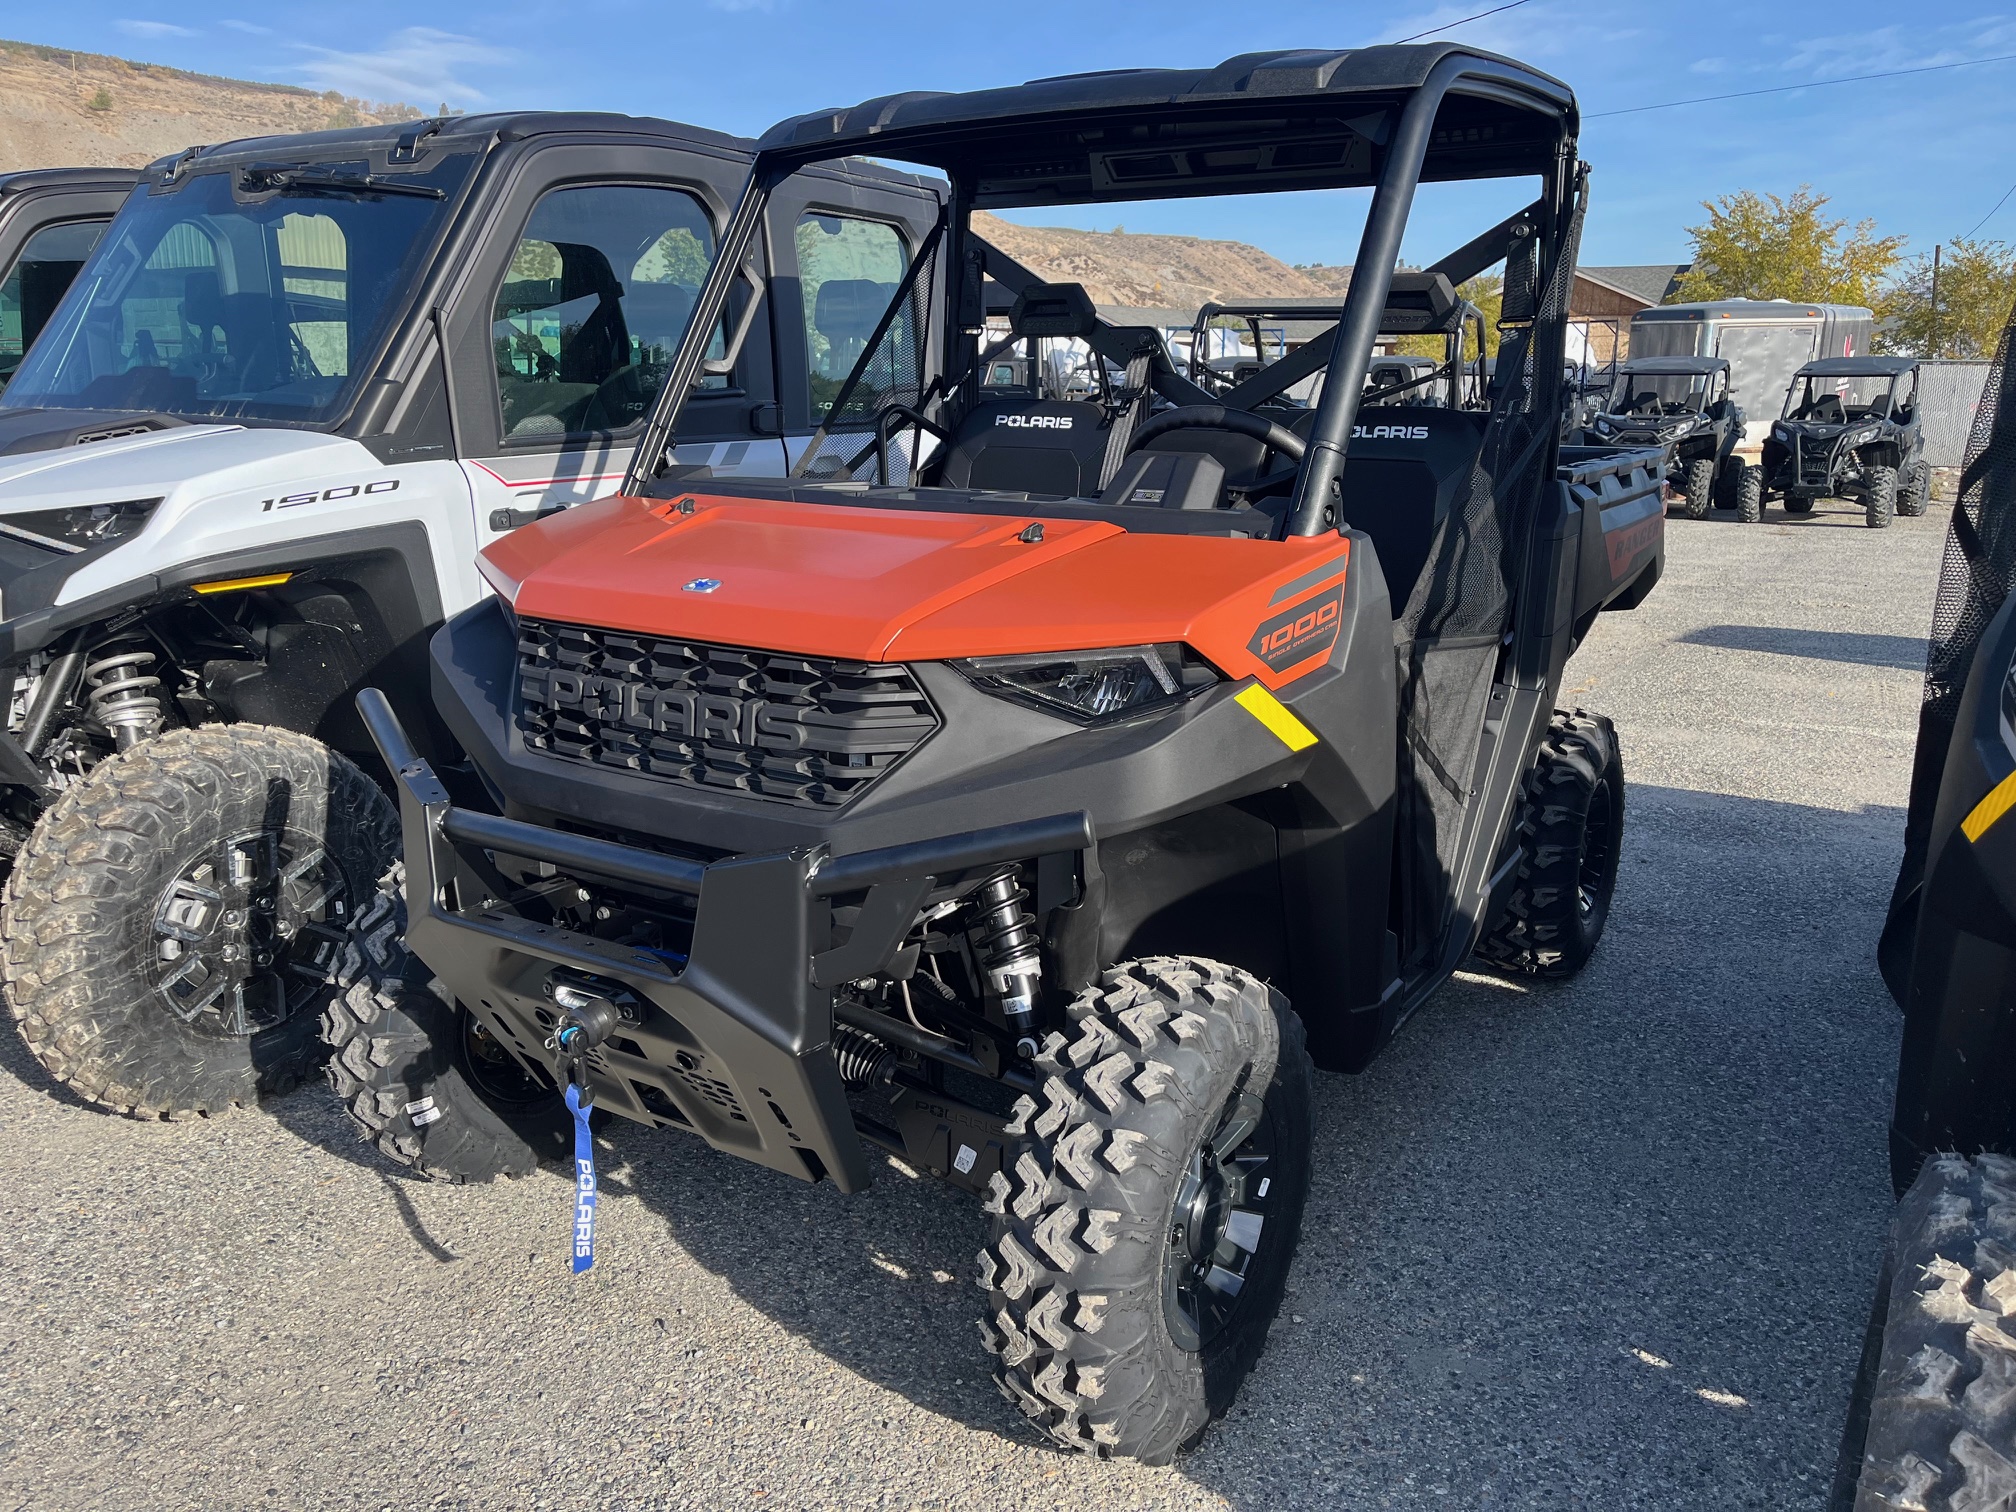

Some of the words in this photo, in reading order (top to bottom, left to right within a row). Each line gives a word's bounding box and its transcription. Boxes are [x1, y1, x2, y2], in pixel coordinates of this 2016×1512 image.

[994, 414, 1073, 429] POLARIS
[1350, 425, 1429, 439] OLARIS
[261, 479, 401, 513] 1500
[1614, 520, 1660, 561] RANGER
[1260, 599, 1338, 656] 1000
[1267, 645, 1292, 661] SINGLE
[547, 669, 808, 750] POLARIS
[915, 1100, 1005, 1138] POLARIS
[575, 1158, 594, 1258] POLARIS
